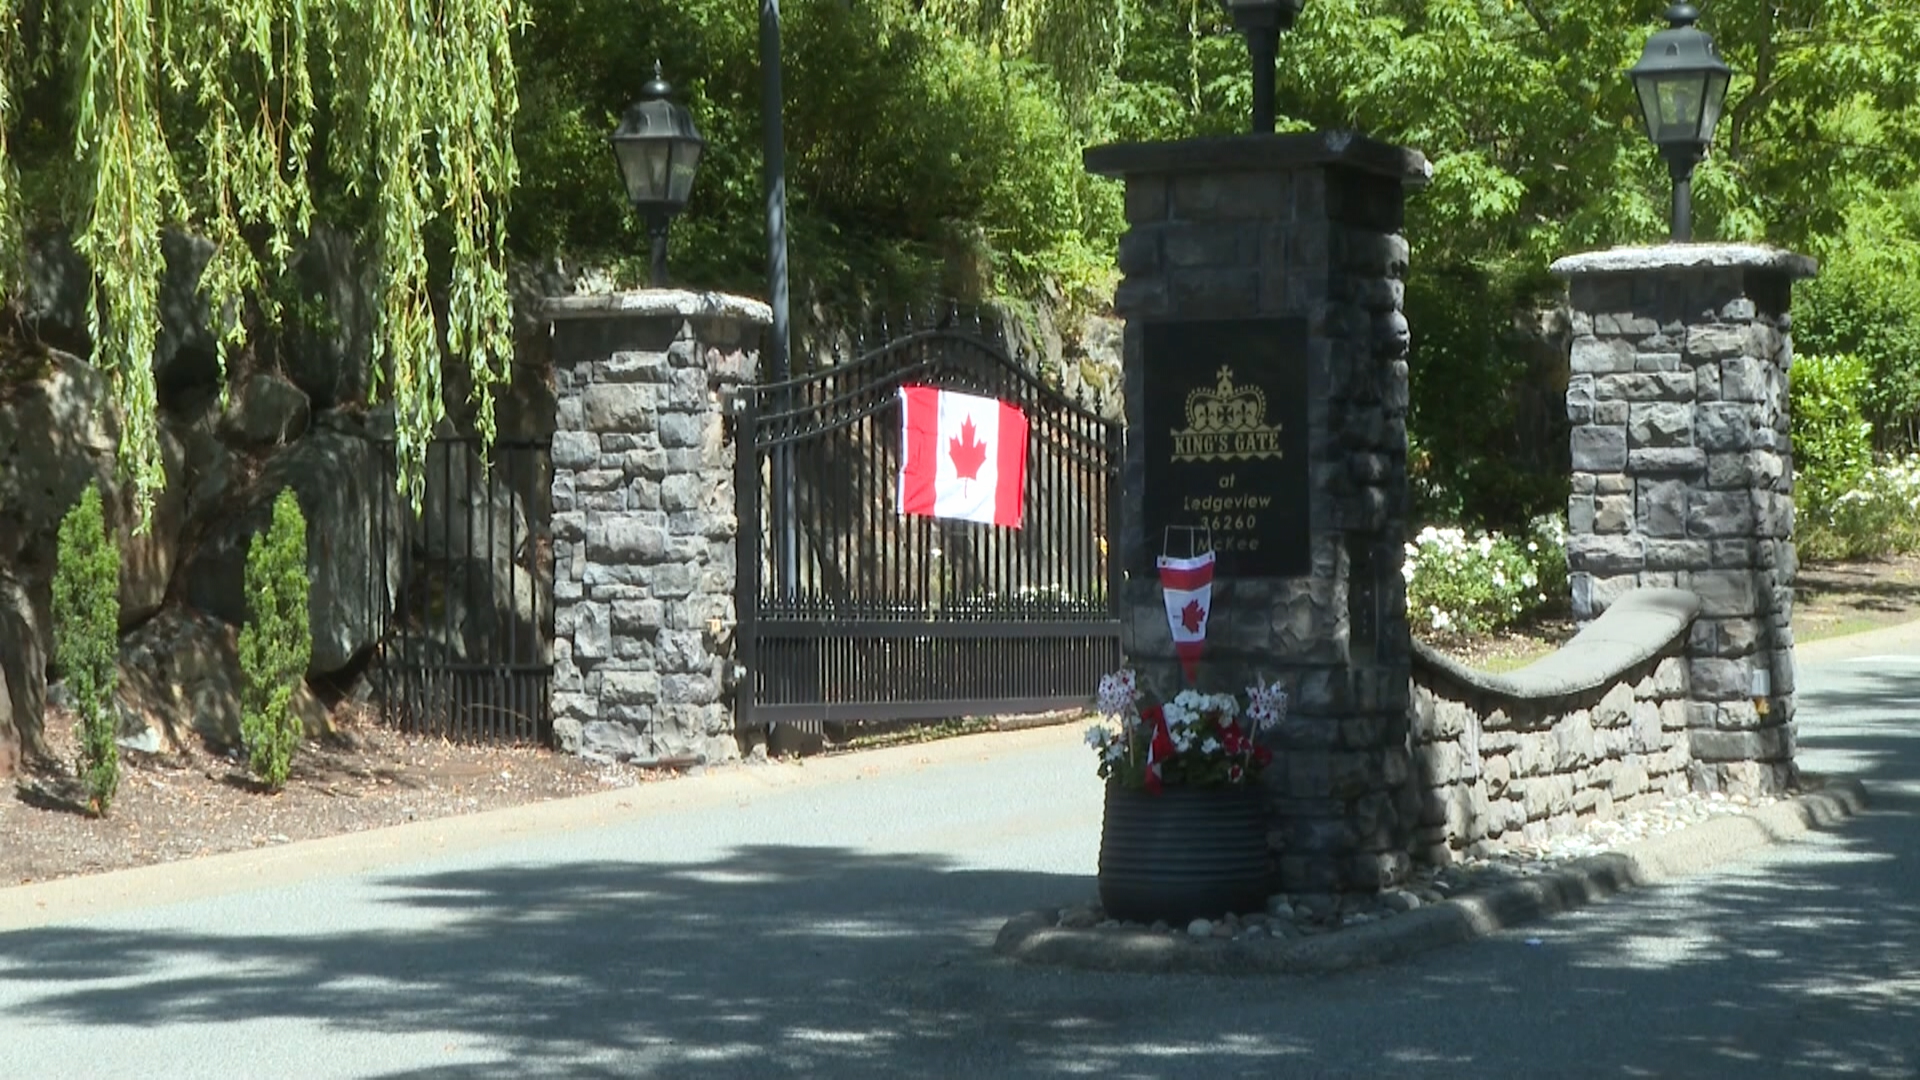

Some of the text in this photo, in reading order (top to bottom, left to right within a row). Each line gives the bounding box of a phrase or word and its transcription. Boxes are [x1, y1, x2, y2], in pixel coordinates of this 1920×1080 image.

[1175, 432, 1279, 454] KING'S GATE
[1219, 473, 1235, 488] at
[1183, 494, 1271, 512] Ledgeview
[1201, 515, 1256, 530] 36260
[1197, 536, 1259, 552] McKee
